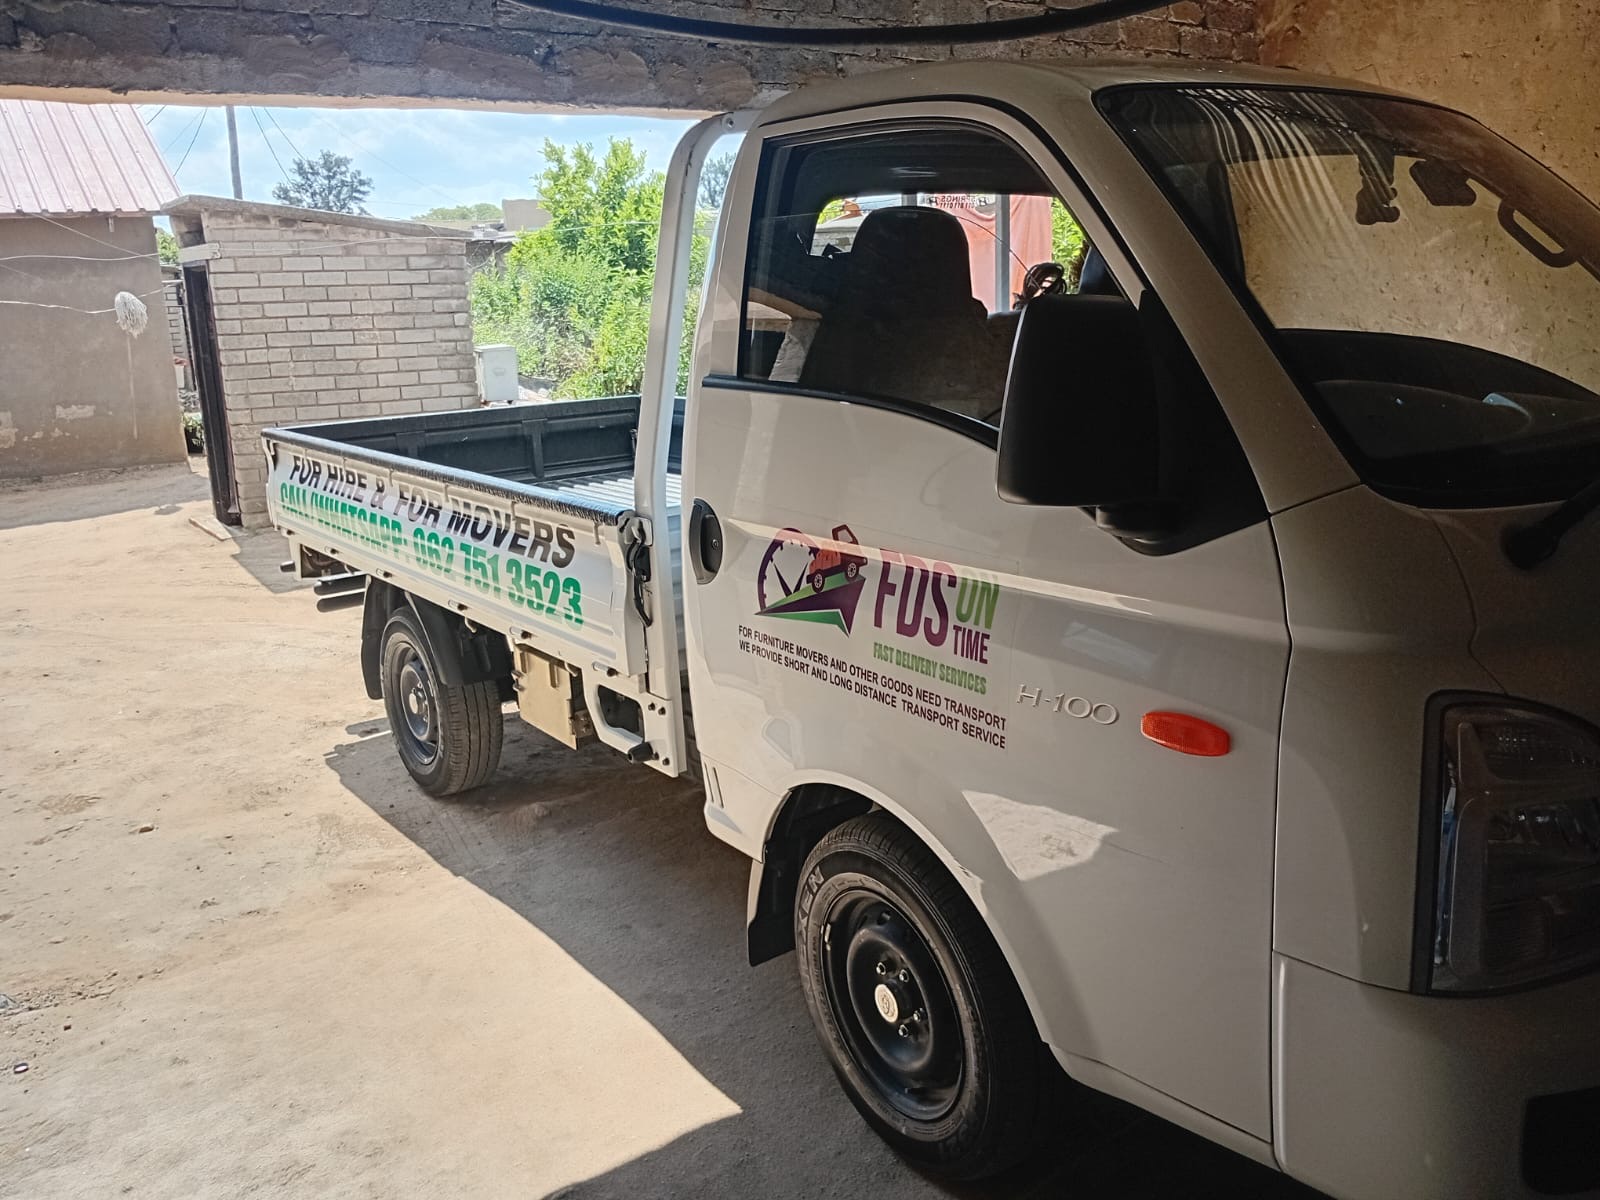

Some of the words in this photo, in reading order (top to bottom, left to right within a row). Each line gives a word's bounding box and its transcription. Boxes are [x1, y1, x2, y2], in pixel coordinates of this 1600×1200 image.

[289, 455, 322, 489] FOR
[323, 464, 368, 503] HIRE
[370, 477, 385, 510] &
[393, 482, 443, 529] FOR
[446, 498, 576, 568] MOVERS
[459, 542, 501, 600] 751
[505, 558, 584, 631] 3523
[873, 548, 957, 647] FDS
[955, 566, 1000, 630] ON
[738, 624, 753, 640] FOR
[753, 630, 795, 655] FURNITURE
[795, 644, 829, 667] MOVERS
[830, 657, 848, 674] AND
[849, 664, 879, 686] OTHER
[880, 675, 914, 698] GOODS
[915, 686, 942, 708] NEED
[943, 697, 1007, 731] TRANSPORT
[873, 641, 894, 664] FAST
[895, 649, 938, 679] DELIVERY
[939, 663, 987, 695] SERVICES
[952, 624, 990, 665] TIME
[739, 639, 751, 653] WE
[751, 644, 783, 665] PROVIDE
[784, 655, 810, 675] SHORT
[811, 665, 828, 682] AND
[829, 672, 853, 692] LONG
[854, 681, 897, 709] DISTANCE
[901, 698, 960, 732] TRANSPORT
[961, 721, 1006, 750] SERVICE
[1015, 683, 1119, 725] H-100
